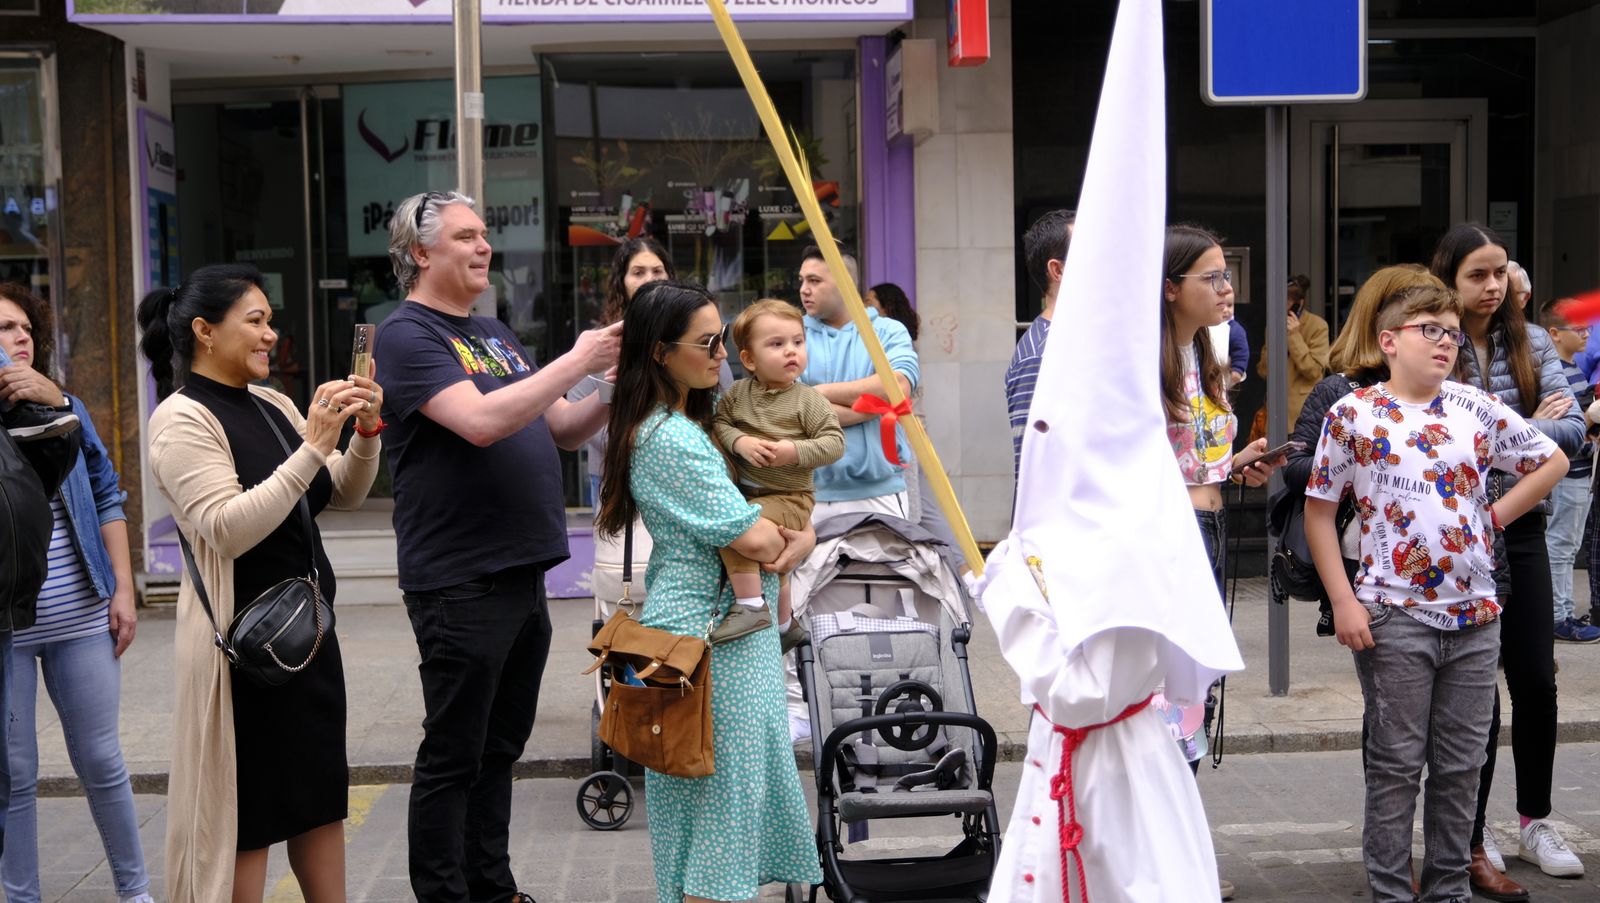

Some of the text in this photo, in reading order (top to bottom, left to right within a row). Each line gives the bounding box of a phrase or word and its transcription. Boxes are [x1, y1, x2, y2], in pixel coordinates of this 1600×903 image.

[413, 118, 540, 151] Flme
[483, 196, 540, 234] apor!
[757, 205, 781, 214] LUXE
[1370, 470, 1432, 496] ICON MILANO
[1380, 541, 1392, 571] MILANO
